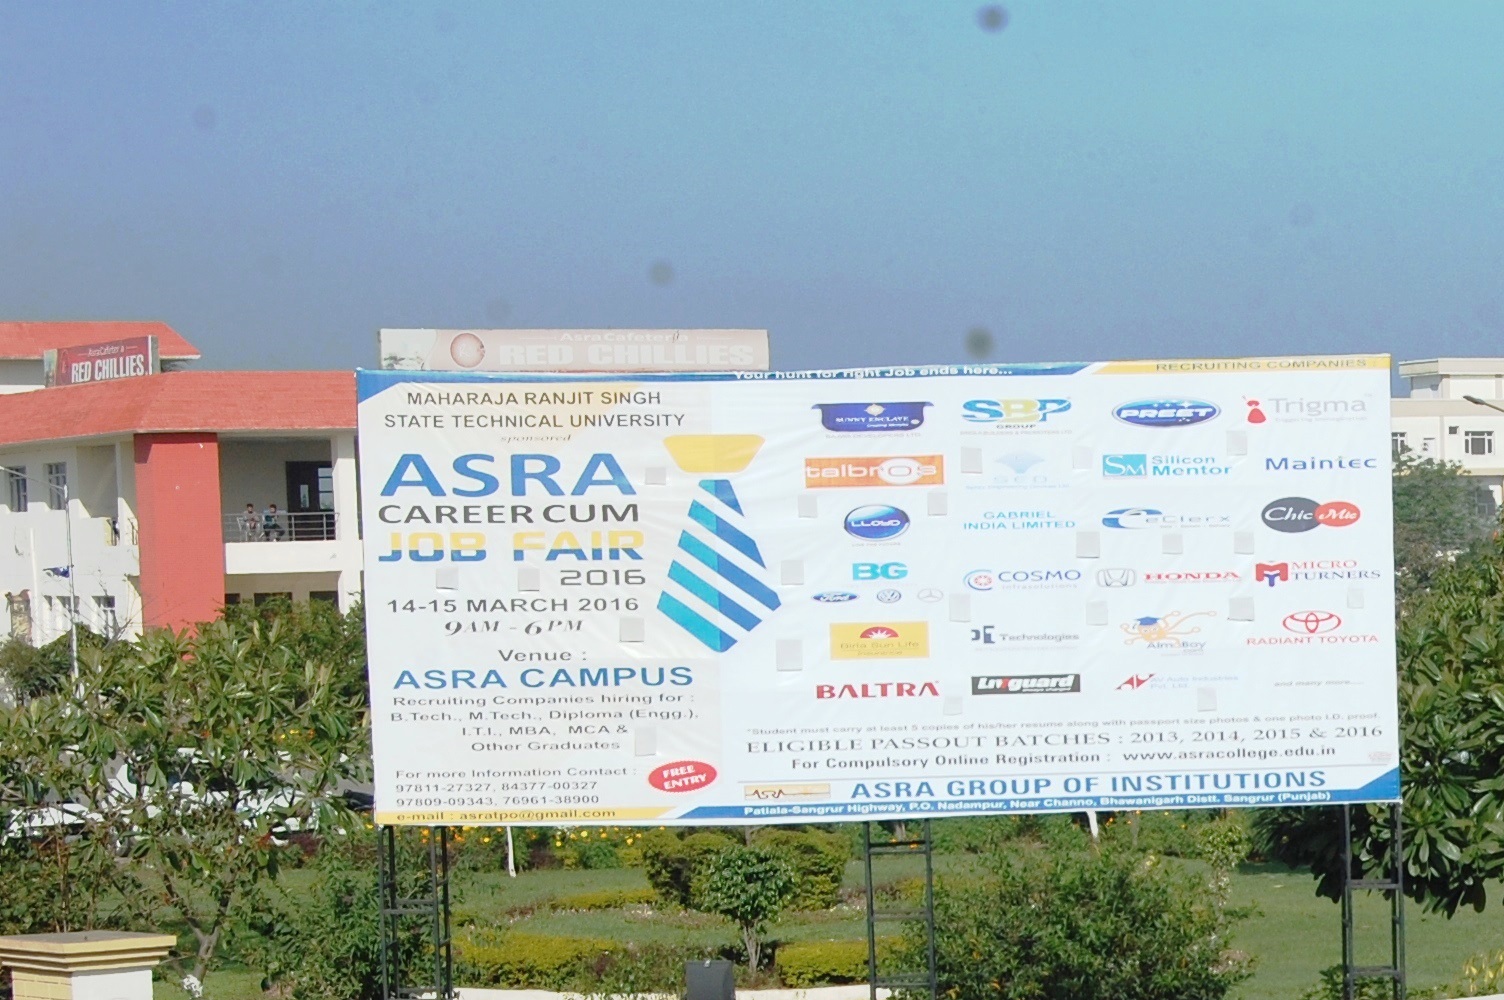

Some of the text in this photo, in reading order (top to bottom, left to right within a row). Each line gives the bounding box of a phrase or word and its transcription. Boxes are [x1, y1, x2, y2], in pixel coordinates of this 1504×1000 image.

[500, 344, 754, 366] RED CHILLIES
[71, 354, 144, 384] RED CHILLIES
[734, 370, 771, 380] Your
[775, 369, 812, 380] hunt
[843, 367, 881, 380] right
[918, 366, 958, 376] ends
[1156, 359, 1367, 372] RECRUITING COMPANIES
[407, 391, 662, 406] MAHARAJA RANJIT SINGH
[962, 398, 1072, 423] SBP
[1121, 406, 1213, 419] PREET
[1267, 398, 1367, 417] Trigma
[384, 413, 685, 429] STATE TECHNICAL UNIVERSITY
[500, 433, 573, 444] sponsored
[1152, 455, 1216, 464] Silicon
[1265, 456, 1378, 471] Maintec
[380, 453, 637, 498] ASRA
[1152, 464, 1232, 477] Mentor
[378, 503, 639, 524] CAREER CUM
[983, 511, 1056, 519] GABRIEL
[1264, 506, 1314, 521] Chic
[851, 520, 902, 528] LLOYD
[963, 520, 1076, 530] INDIA LIMITED
[378, 529, 645, 563] JOB FAIR
[852, 562, 908, 581] BG
[1291, 560, 1358, 569] MICRO
[560, 569, 646, 586] 2016
[998, 570, 1081, 582] COSMO
[1145, 572, 1240, 580] HONDA
[1291, 569, 1381, 581] TURNERS
[387, 597, 639, 613] 14-15 MARCH 2016
[1247, 635, 1379, 646] RADIANT TOYOTA
[393, 666, 694, 690] ASRA CAMPUS
[816, 681, 940, 700] BALTRA
[393, 693, 684, 708] Recruiting Companies hiring for
[549, 709, 624, 721] Diploma
[568, 725, 610, 735] MCA
[616, 724, 629, 734] &
[833, 726, 863, 734] carry
[1066, 720, 1099, 728] along
[1129, 718, 1180, 726] passport
[1209, 716, 1249, 724] photos
[1289, 714, 1322, 722] photo
[471, 740, 621, 752] Other Graduates
[746, 738, 863, 753] ELIGIBLE
[871, 735, 988, 751] PASSOUT
[995, 732, 1110, 748] BATCHES
[1253, 728, 1301, 740] 2015
[1309, 727, 1327, 739] &
[1335, 726, 1383, 738] 2016
[792, 745, 1336, 770] For Compulsory Online Registration www.asracollege.edu.in
[396, 767, 627, 780] For more Information Contact
[662, 764, 707, 790] FREE ENTRY
[851, 770, 1326, 799] ASRA GROUP OF INSTITUTIONS
[744, 804, 844, 816] Patiala-Sangrur
[1010, 799, 1040, 808] Near
[1100, 794, 1184, 806] Bhawanigarh
[1223, 793, 1275, 804] Sangrur
[1278, 791, 1331, 802] (Punjab)
